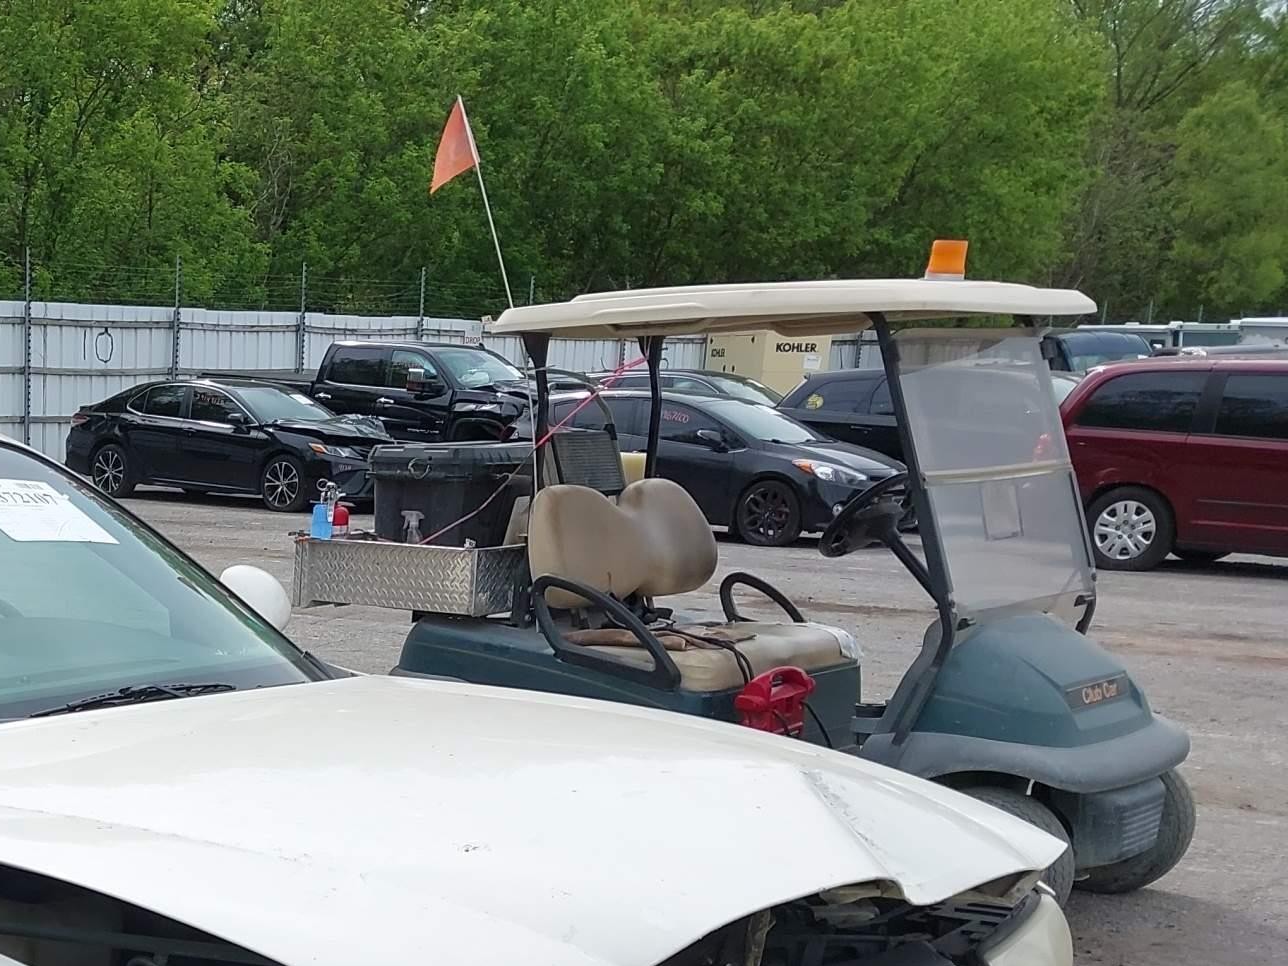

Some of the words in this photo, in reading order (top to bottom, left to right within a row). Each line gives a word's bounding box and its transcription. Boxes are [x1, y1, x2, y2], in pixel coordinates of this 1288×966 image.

[83, 327, 114, 363] 10
[775, 342, 817, 353] KOHLER
[1082, 685, 1103, 704] Club
[1103, 681, 1118, 698] Car
